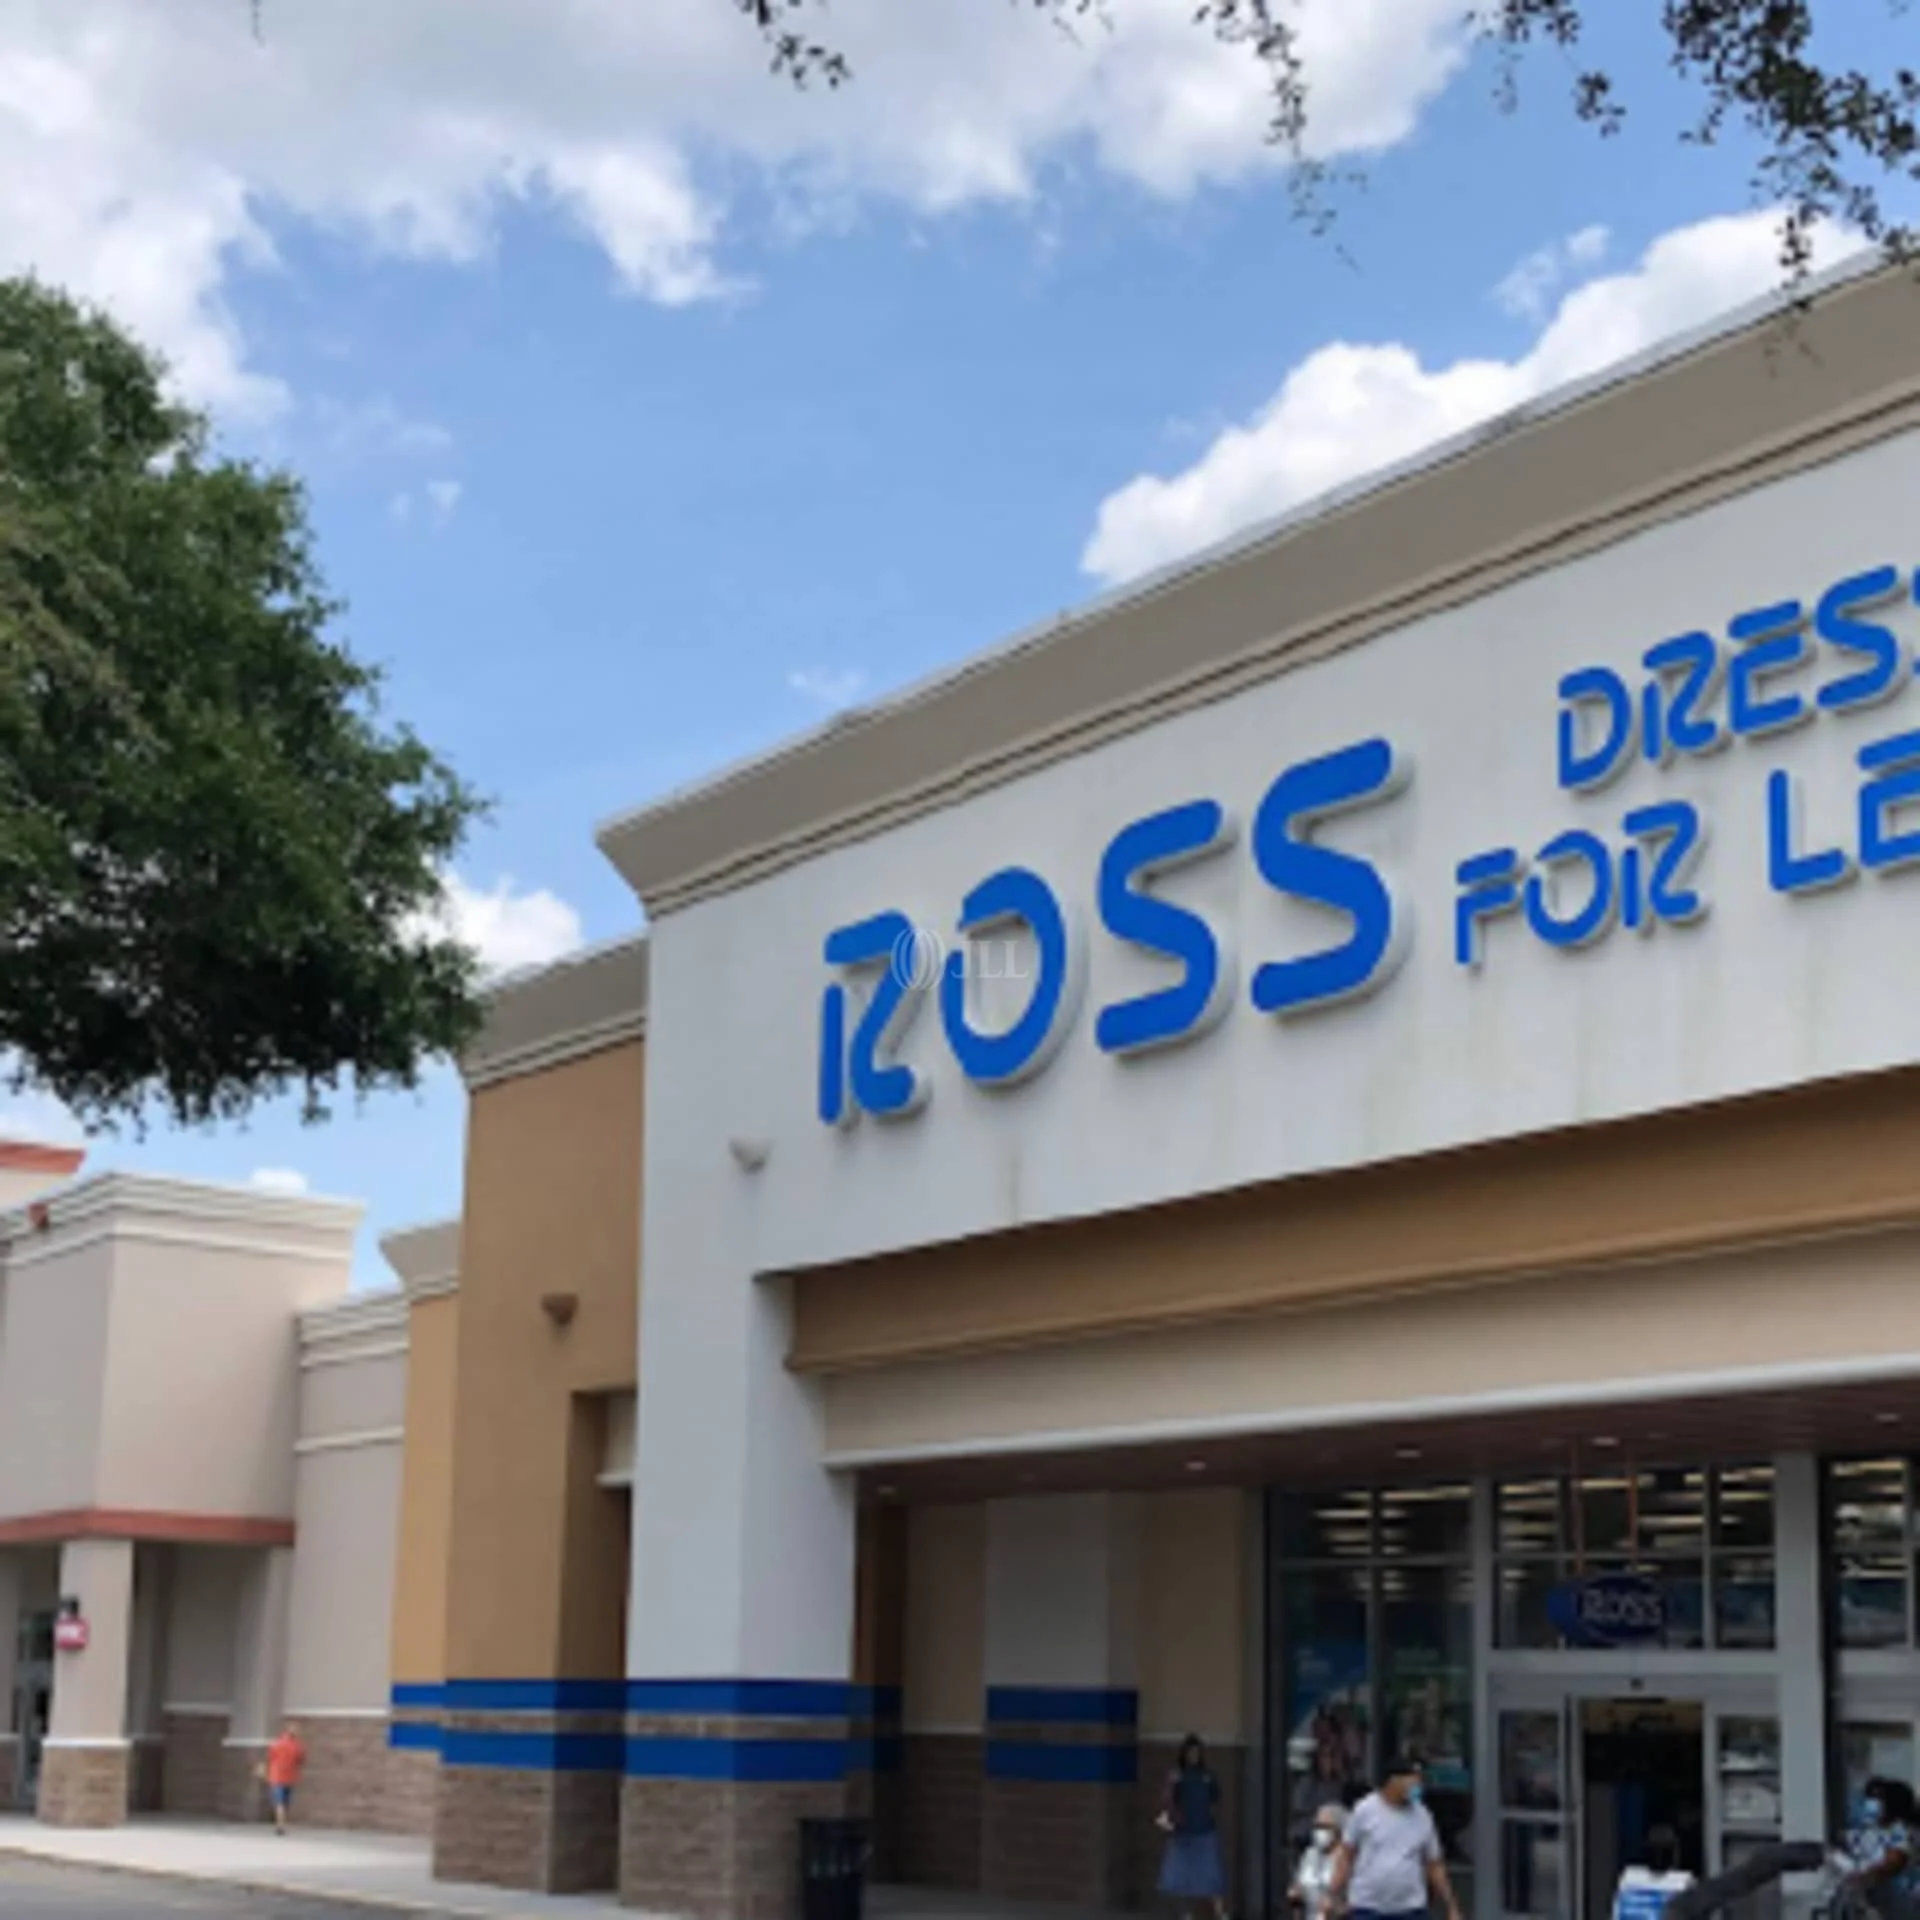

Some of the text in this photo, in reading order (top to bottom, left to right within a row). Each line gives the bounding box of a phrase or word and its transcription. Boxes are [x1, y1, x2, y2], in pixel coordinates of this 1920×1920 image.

[1557, 566, 1920, 788] DRES
[818, 737, 1394, 1124] ROSS
[1455, 800, 1698, 964] FOR
[1581, 1587, 1663, 1627] ROSS
